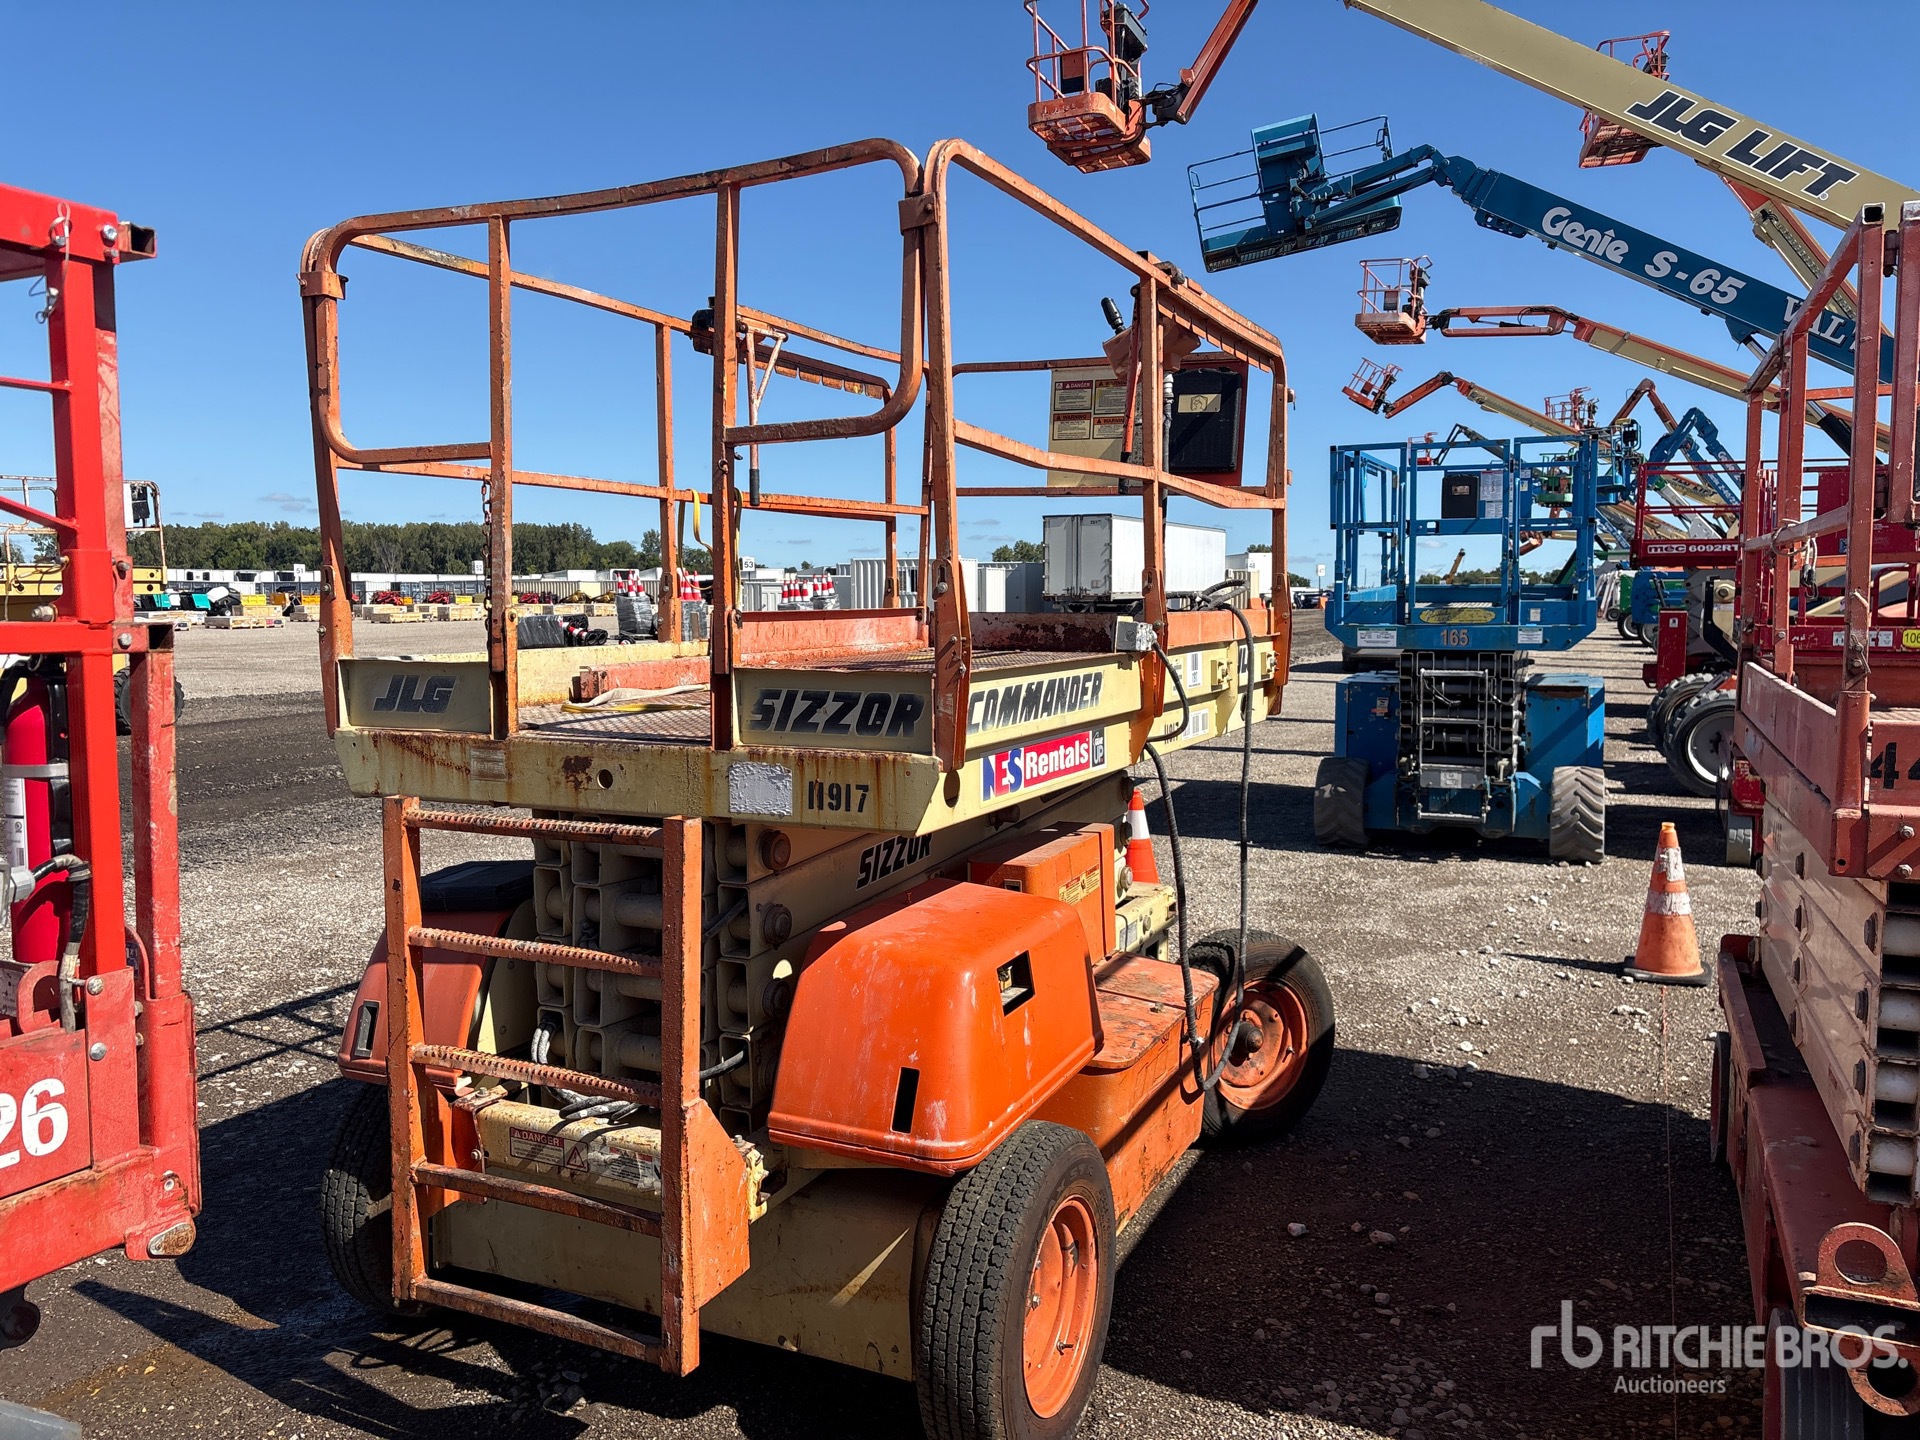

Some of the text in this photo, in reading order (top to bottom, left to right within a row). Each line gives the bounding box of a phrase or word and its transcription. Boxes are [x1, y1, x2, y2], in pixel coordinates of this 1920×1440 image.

[1624, 89, 1860, 200] JLG LIFT
[1542, 206, 1629, 264] Genie
[744, 560, 754, 569] 53
[1440, 629, 1469, 646] 165
[373, 674, 457, 714] JLG
[750, 688, 925, 738] SIZZOR
[966, 671, 1103, 736] COMMANDER
[982, 738, 1089, 802] NES Rentals
[808, 780, 869, 813] 11917
[521, 1131, 561, 1147] DANGER
